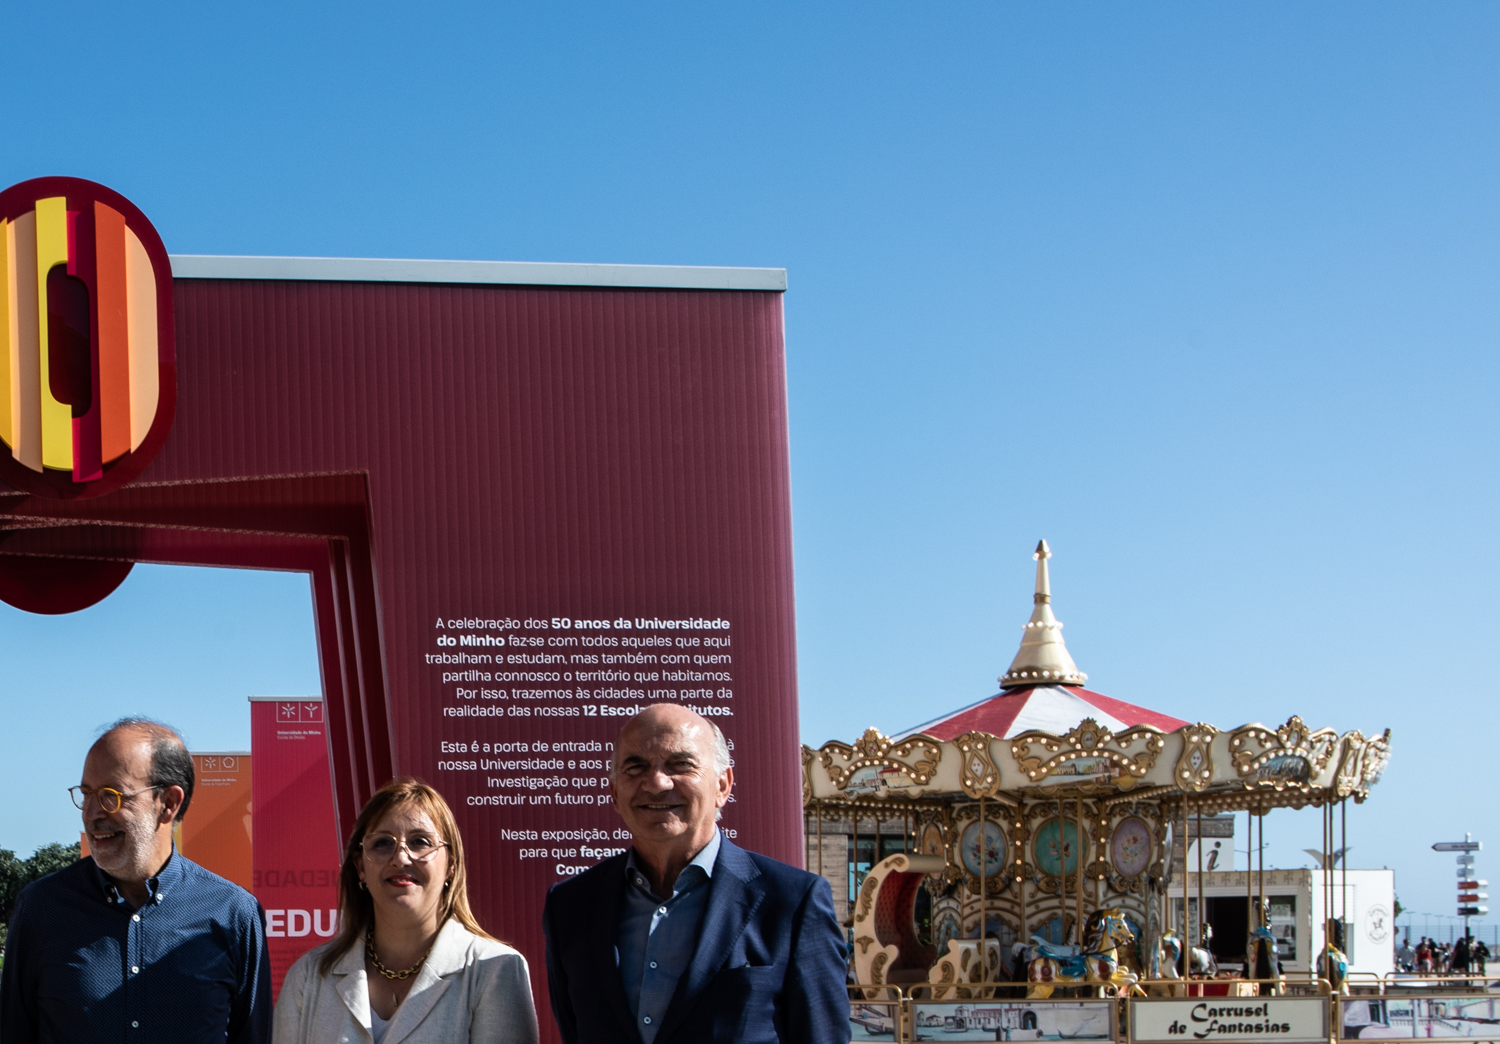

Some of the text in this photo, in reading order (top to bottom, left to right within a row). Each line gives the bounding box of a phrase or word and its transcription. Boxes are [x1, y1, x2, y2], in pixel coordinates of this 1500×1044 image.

[435, 617, 731, 632] A celebração dos 50 anos da Universidade
[437, 635, 731, 649] do Minho faz-se com todos aqueles que aqui
[425, 652, 732, 666] trabalham e estudam, mas também com quem
[442, 669, 733, 684] partilha connosco o território que habitamos.
[456, 686, 733, 701] Por isso, trazemos às cidades uma parte da
[443, 704, 504, 717] realidade
[507, 704, 531, 717] das
[534, 707, 580, 717] nossas
[582, 705, 598, 717] 12
[441, 741, 468, 754] Esta
[470, 740, 480, 753] é
[483, 743, 491, 753] a
[494, 741, 529, 755] porta
[532, 740, 549, 752] de
[552, 740, 602, 752] entrada
[438, 760, 477, 771] nossa
[480, 758, 564, 771] Universidade
[567, 760, 576, 770] e
[579, 759, 602, 769] aos
[487, 776, 569, 790] Investigação
[571, 777, 597, 789] que
[466, 793, 526, 806] construir
[529, 796, 551, 805] um
[555, 793, 594, 805] futuro
[501, 829, 538, 841] Nesta
[541, 828, 610, 843] exposição,
[519, 848, 548, 860] para
[551, 848, 577, 860] que
[1190, 1002, 1269, 1023] Carrusel
[1168, 1020, 1187, 1035] de
